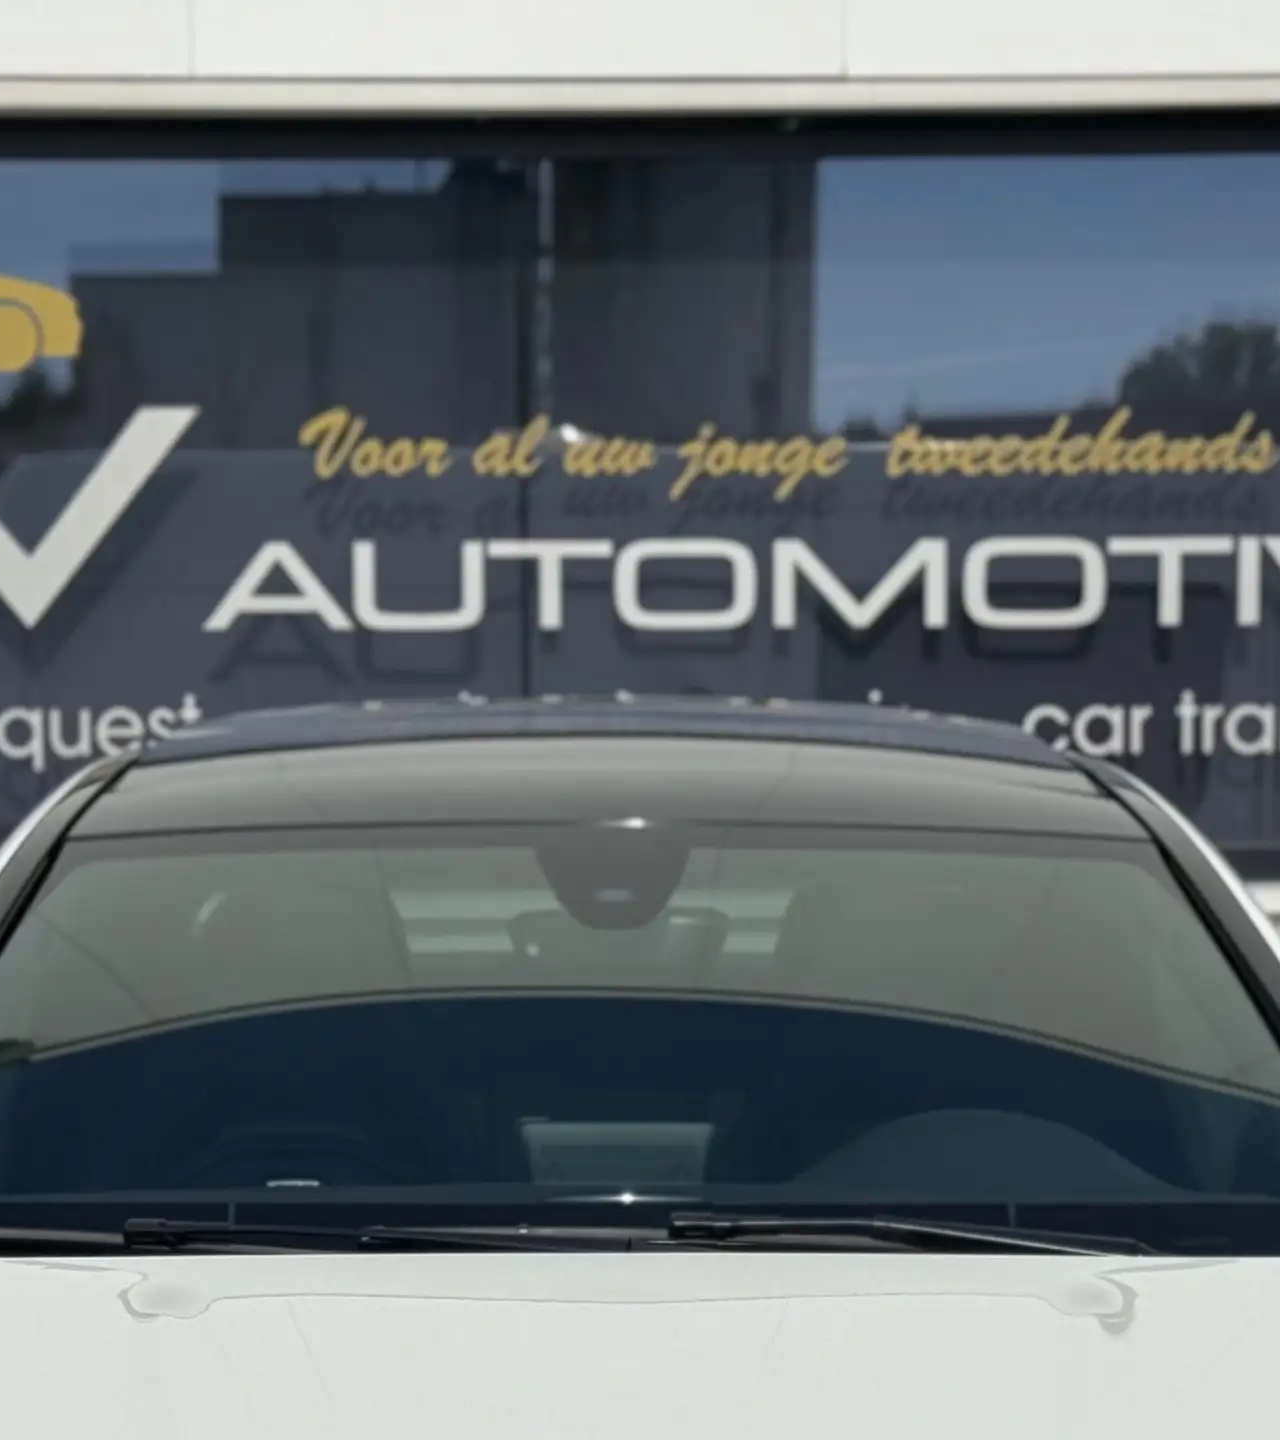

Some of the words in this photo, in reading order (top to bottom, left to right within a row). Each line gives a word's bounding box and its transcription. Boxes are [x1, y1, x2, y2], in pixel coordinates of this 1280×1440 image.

[297, 407, 452, 478] Voor
[472, 412, 550, 478] al
[560, 433, 658, 478] uw
[668, 421, 848, 501] jonge
[884, 404, 1278, 477] tweedehands
[1020, 703, 1155, 757] car
